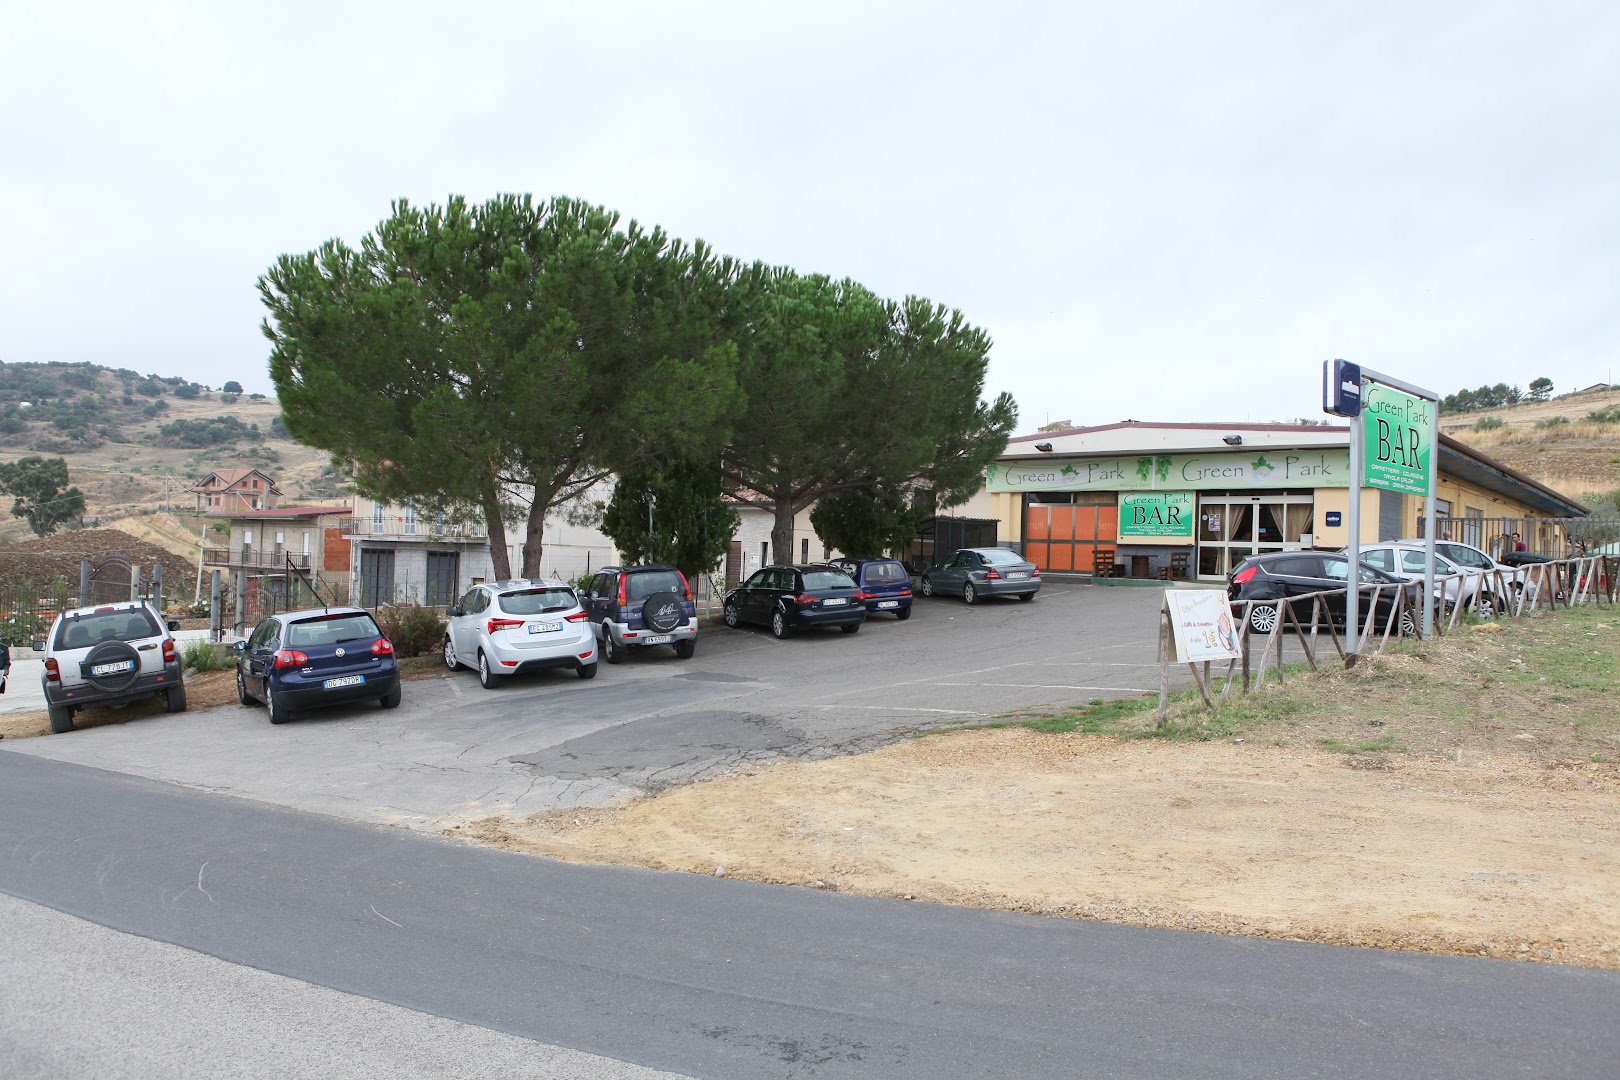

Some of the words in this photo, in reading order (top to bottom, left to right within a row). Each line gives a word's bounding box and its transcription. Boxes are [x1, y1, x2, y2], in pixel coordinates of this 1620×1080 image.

[1367, 388, 1403, 418] Green
[1406, 398, 1428, 426] Park
[1376, 417, 1422, 471] BAR
[1005, 465, 1055, 486] Green
[1087, 460, 1126, 484] Park
[1181, 458, 1244, 482] Green
[1284, 454, 1332, 480] Park
[1123, 493, 1161, 506] Green
[1163, 493, 1190, 506] Park
[1132, 506, 1183, 525] BAR
